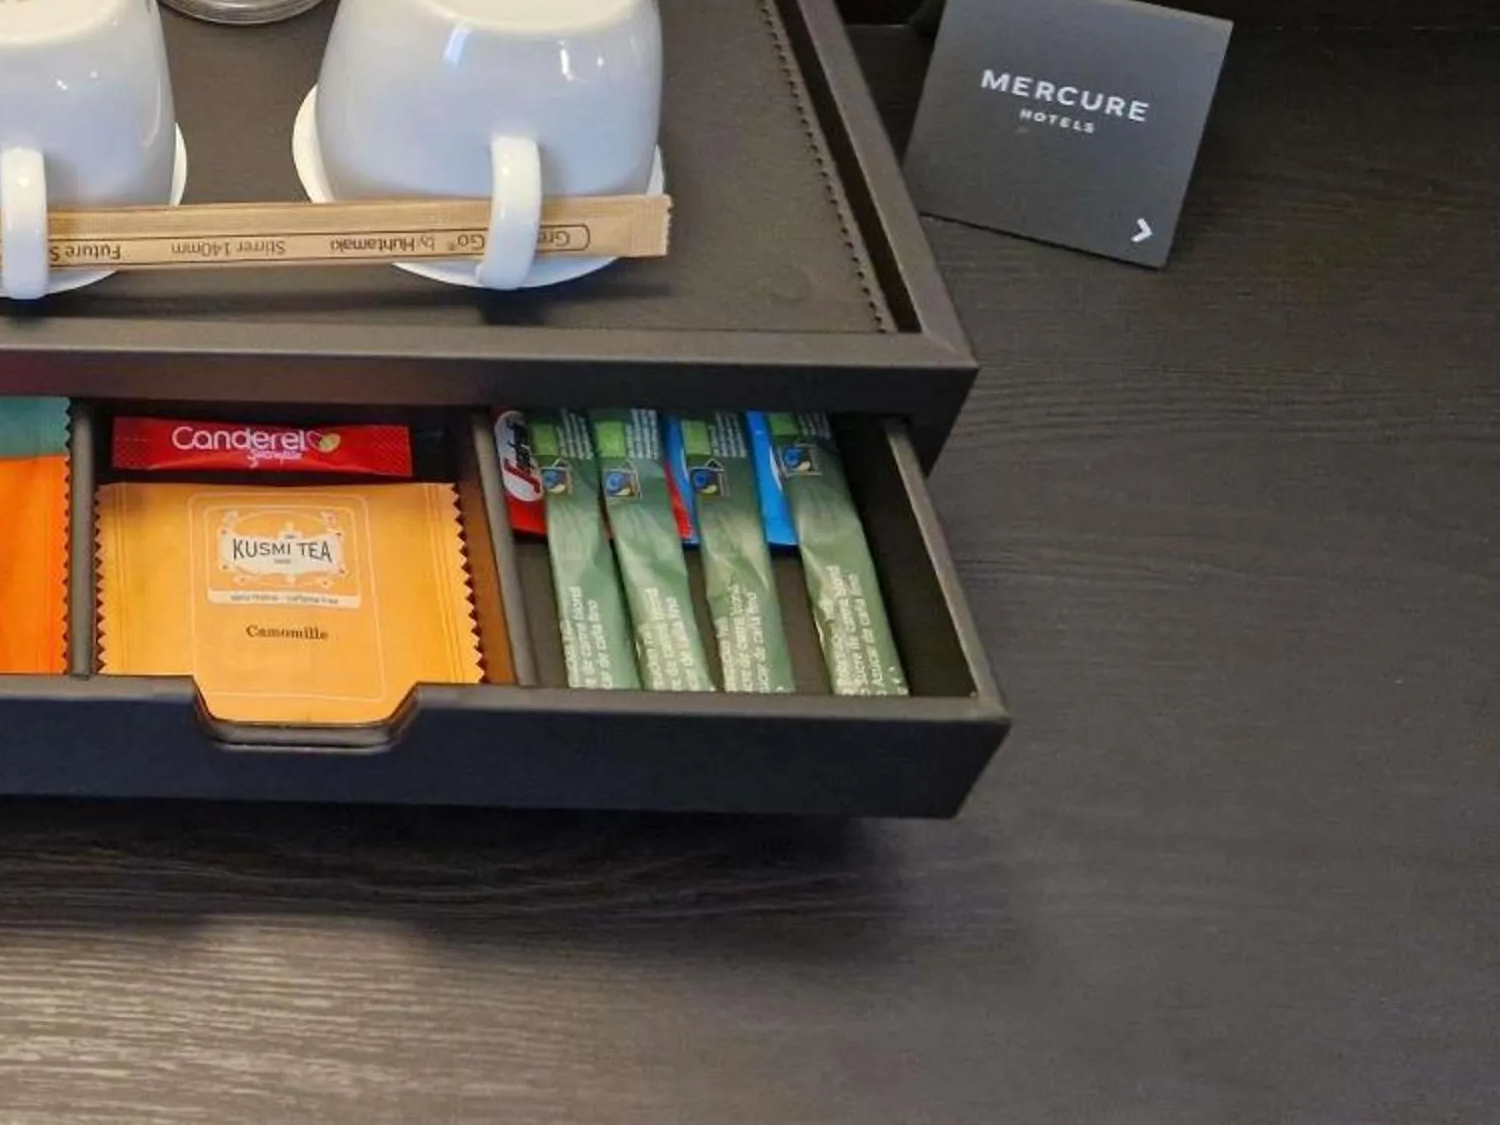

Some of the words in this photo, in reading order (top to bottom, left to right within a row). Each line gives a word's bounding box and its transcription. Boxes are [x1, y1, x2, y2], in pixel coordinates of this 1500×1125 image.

[980, 68, 1149, 122] MERCURE
[1019, 108, 1095, 134] HOTELS
[171, 240, 231, 257] 140mm
[237, 239, 287, 255] Stirrer
[330, 235, 415, 252] Huhtamaki
[420, 234, 435, 250] by
[64, 242, 121, 260] Future
[171, 426, 308, 452] Canderel
[233, 537, 291, 560] KUSMI
[296, 540, 333, 564] TEA
[245, 624, 329, 640] Camomille
